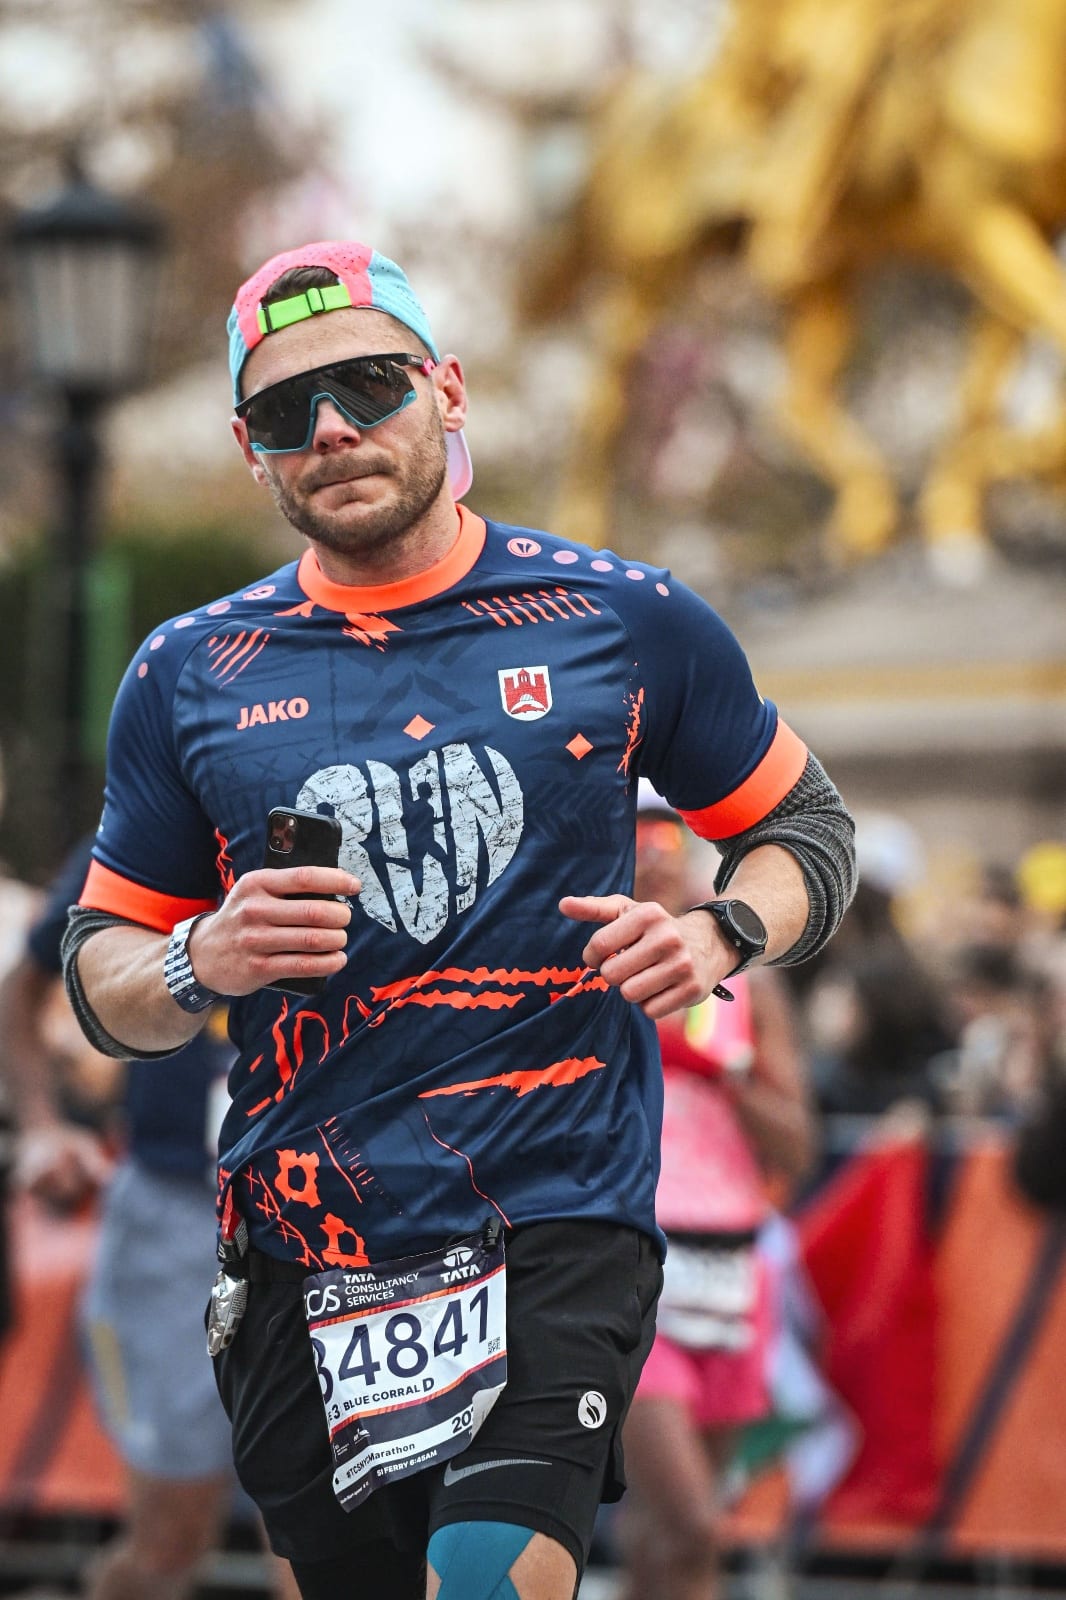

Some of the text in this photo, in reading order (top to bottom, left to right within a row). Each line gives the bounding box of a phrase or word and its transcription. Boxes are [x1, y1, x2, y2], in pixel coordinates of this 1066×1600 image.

[236, 697, 309, 730] JAKO
[343, 1272, 376, 1284] TATA
[345, 1272, 419, 1295] CONSULTANCY
[440, 1264, 481, 1284] TATA
[304, 1284, 341, 1321] CS
[347, 1289, 395, 1308] SERVICES
[331, 1403, 341, 1420] 3
[343, 1395, 370, 1411] BLUE
[372, 1384, 421, 1402] CORRAL
[422, 1377, 435, 1393] D
[452, 1405, 474, 1434] 20
[384, 1461, 408, 1475] FERRY
[410, 1449, 438, 1466] 6:45AM
